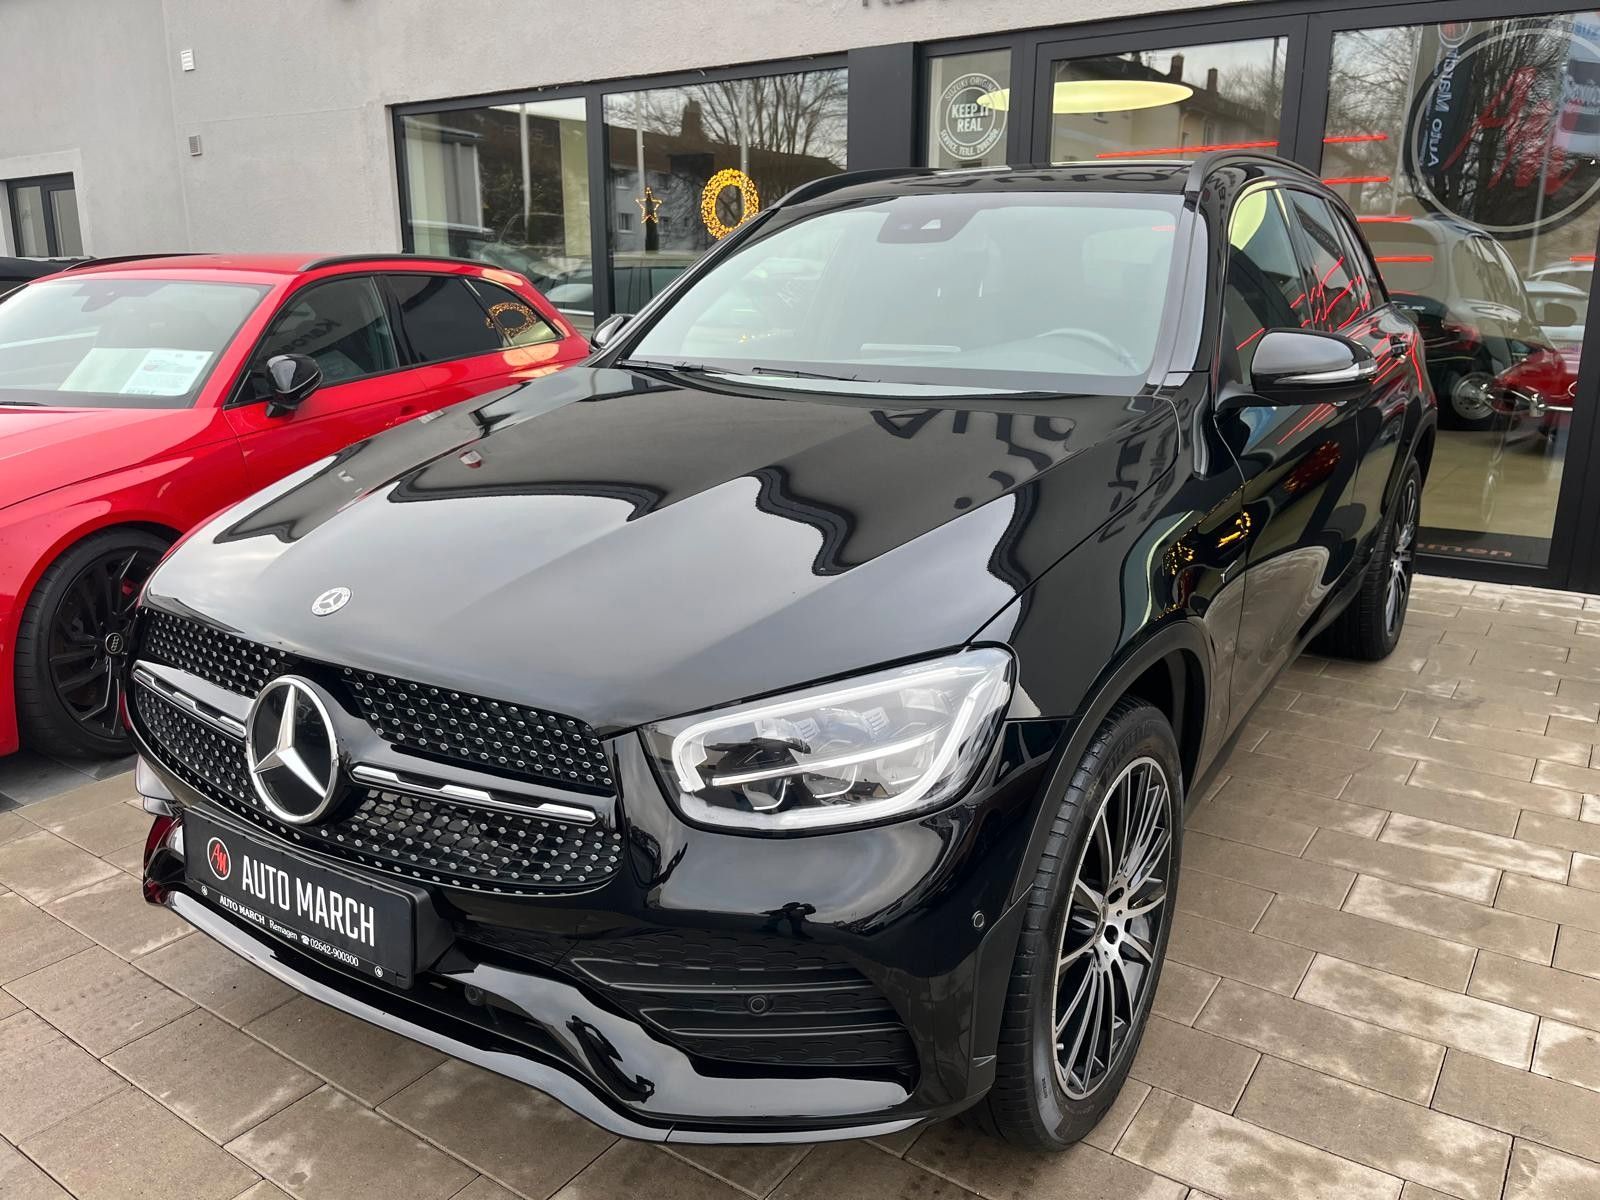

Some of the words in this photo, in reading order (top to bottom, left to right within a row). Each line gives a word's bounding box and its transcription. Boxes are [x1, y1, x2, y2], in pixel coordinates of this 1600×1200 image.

[951, 103, 978, 118] KEEP
[957, 118, 983, 132] REAL
[242, 855, 290, 911] AUTO
[296, 877, 375, 947] MARCH
[220, 896, 238, 912] AUTO
[239, 905, 265, 925] MARCH
[269, 919, 298, 941] Remagen
[310, 938, 359, 967] 02642-900300
